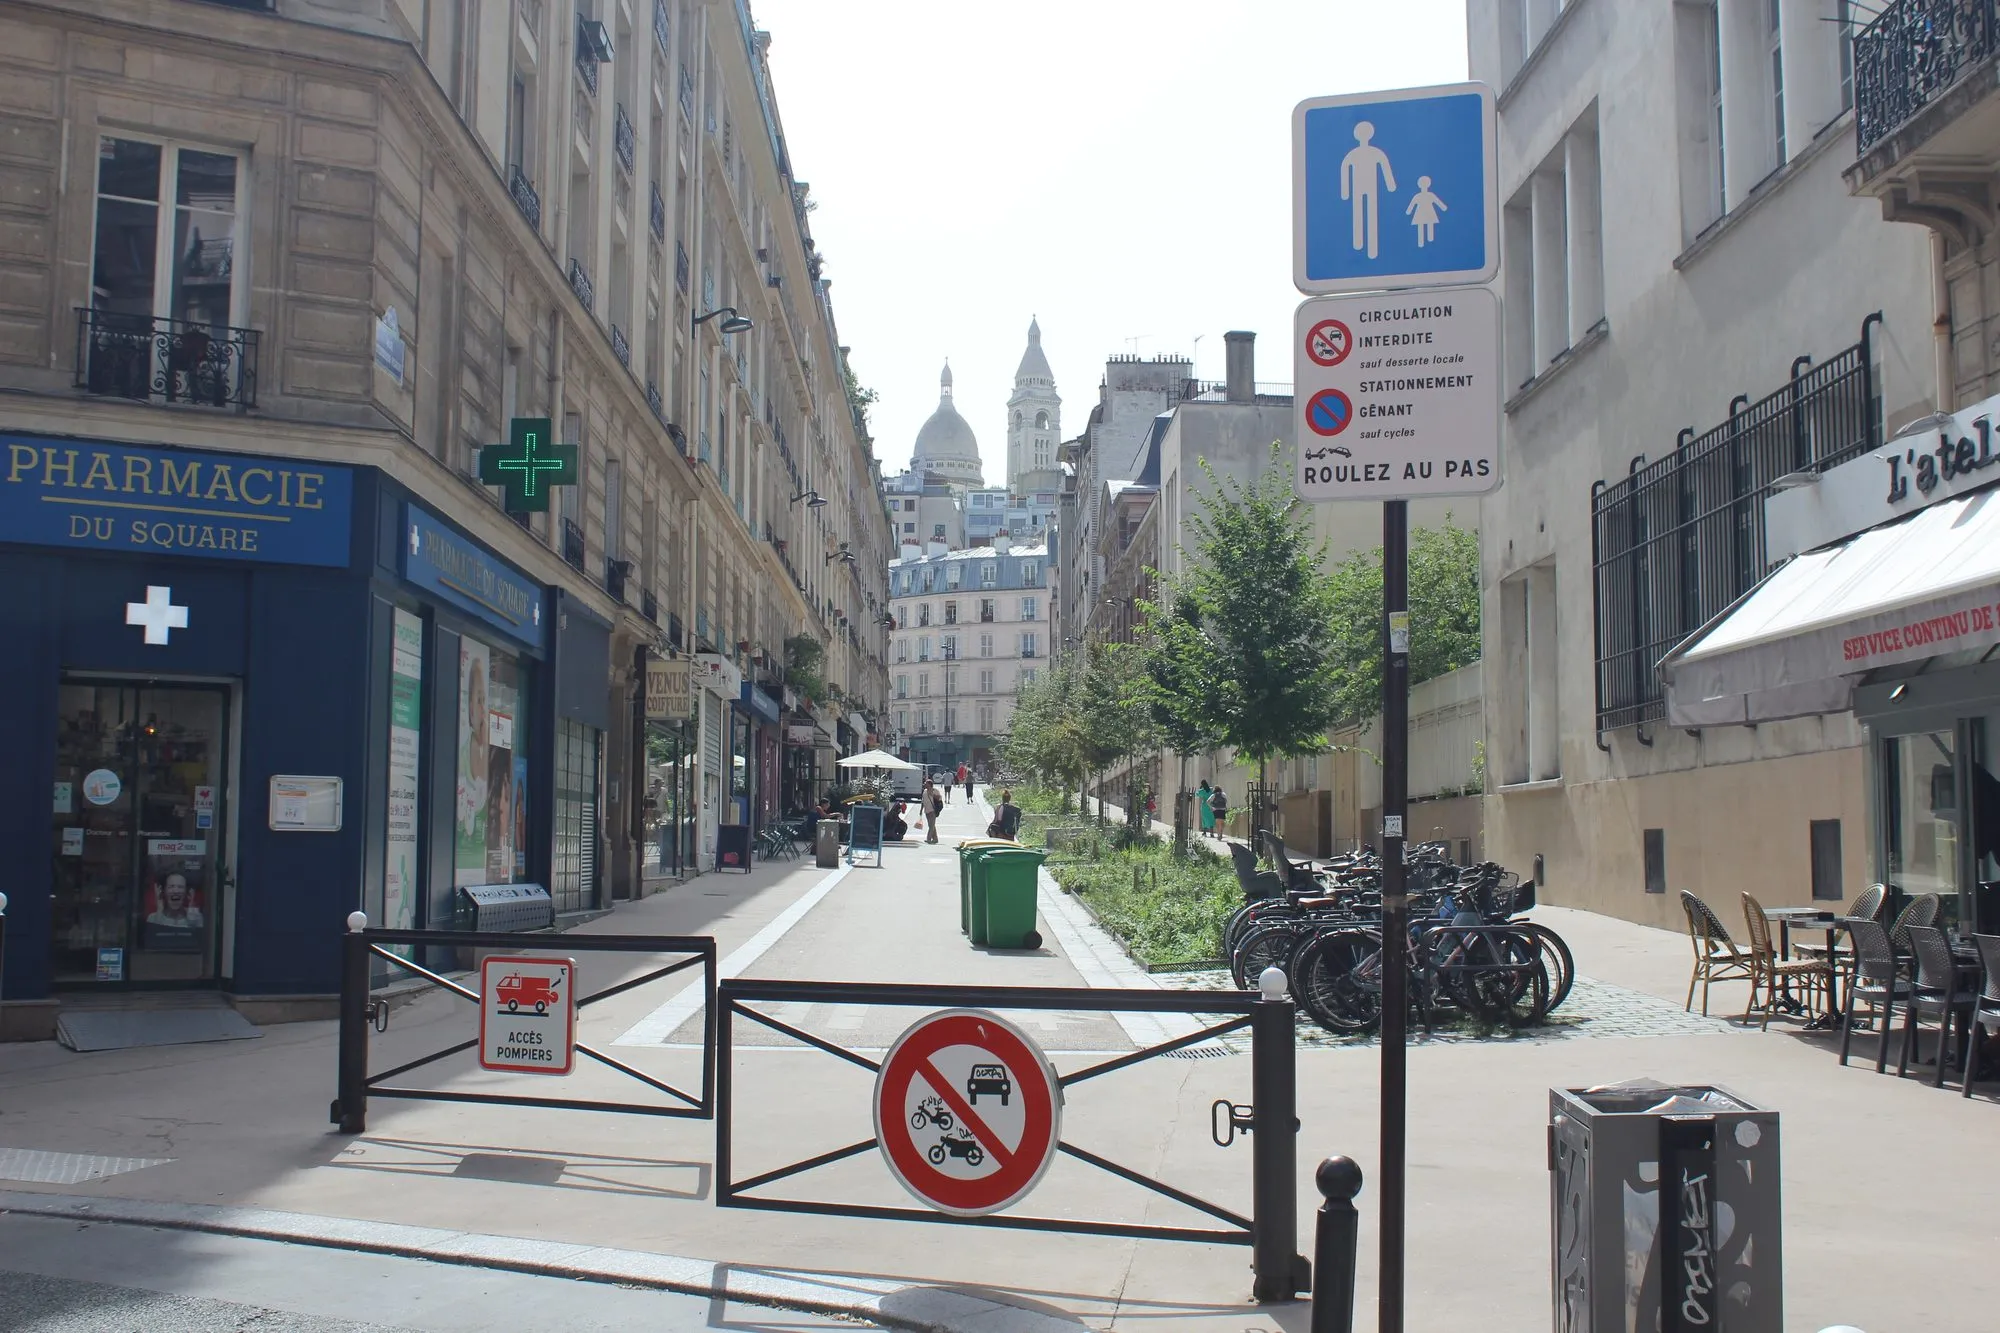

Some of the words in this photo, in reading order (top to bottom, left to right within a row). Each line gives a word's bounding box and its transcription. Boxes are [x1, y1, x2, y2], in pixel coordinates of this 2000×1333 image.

[1359, 305, 1453, 323] CIRCULATION
[1359, 332, 1433, 348] INTERDITE
[1360, 358, 1383, 369] sauf
[1385, 356, 1429, 368] desserte
[1432, 354, 1464, 364] locale
[1359, 375, 1474, 393] STATIONNEMENT
[1359, 404, 1413, 418] GÊNANT
[1360, 429, 1382, 439] sauf
[1384, 427, 1415, 440] cycles
[1886, 419, 2000, 504] L'atel
[7, 445, 324, 509] PHARMACIE
[1304, 463, 1391, 484] ROULEZ
[1403, 461, 1432, 480] AU
[1445, 459, 1490, 478] PAS
[69, 515, 114, 540] DU
[131, 520, 258, 551] SQUARE
[424, 529, 482, 591] PHARMACIE
[482, 568, 496, 599] DU
[497, 577, 529, 617] SQUARE
[1843, 628, 1903, 661] SERVICE
[1903, 611, 1969, 647] CONTINU
[1971, 605, 1994, 632] DE
[647, 671, 690, 694] VENUS
[646, 696, 689, 714] COIFFURE
[508, 1030, 543, 1045] ACCÈS
[497, 1047, 552, 1061] POMPIERS
